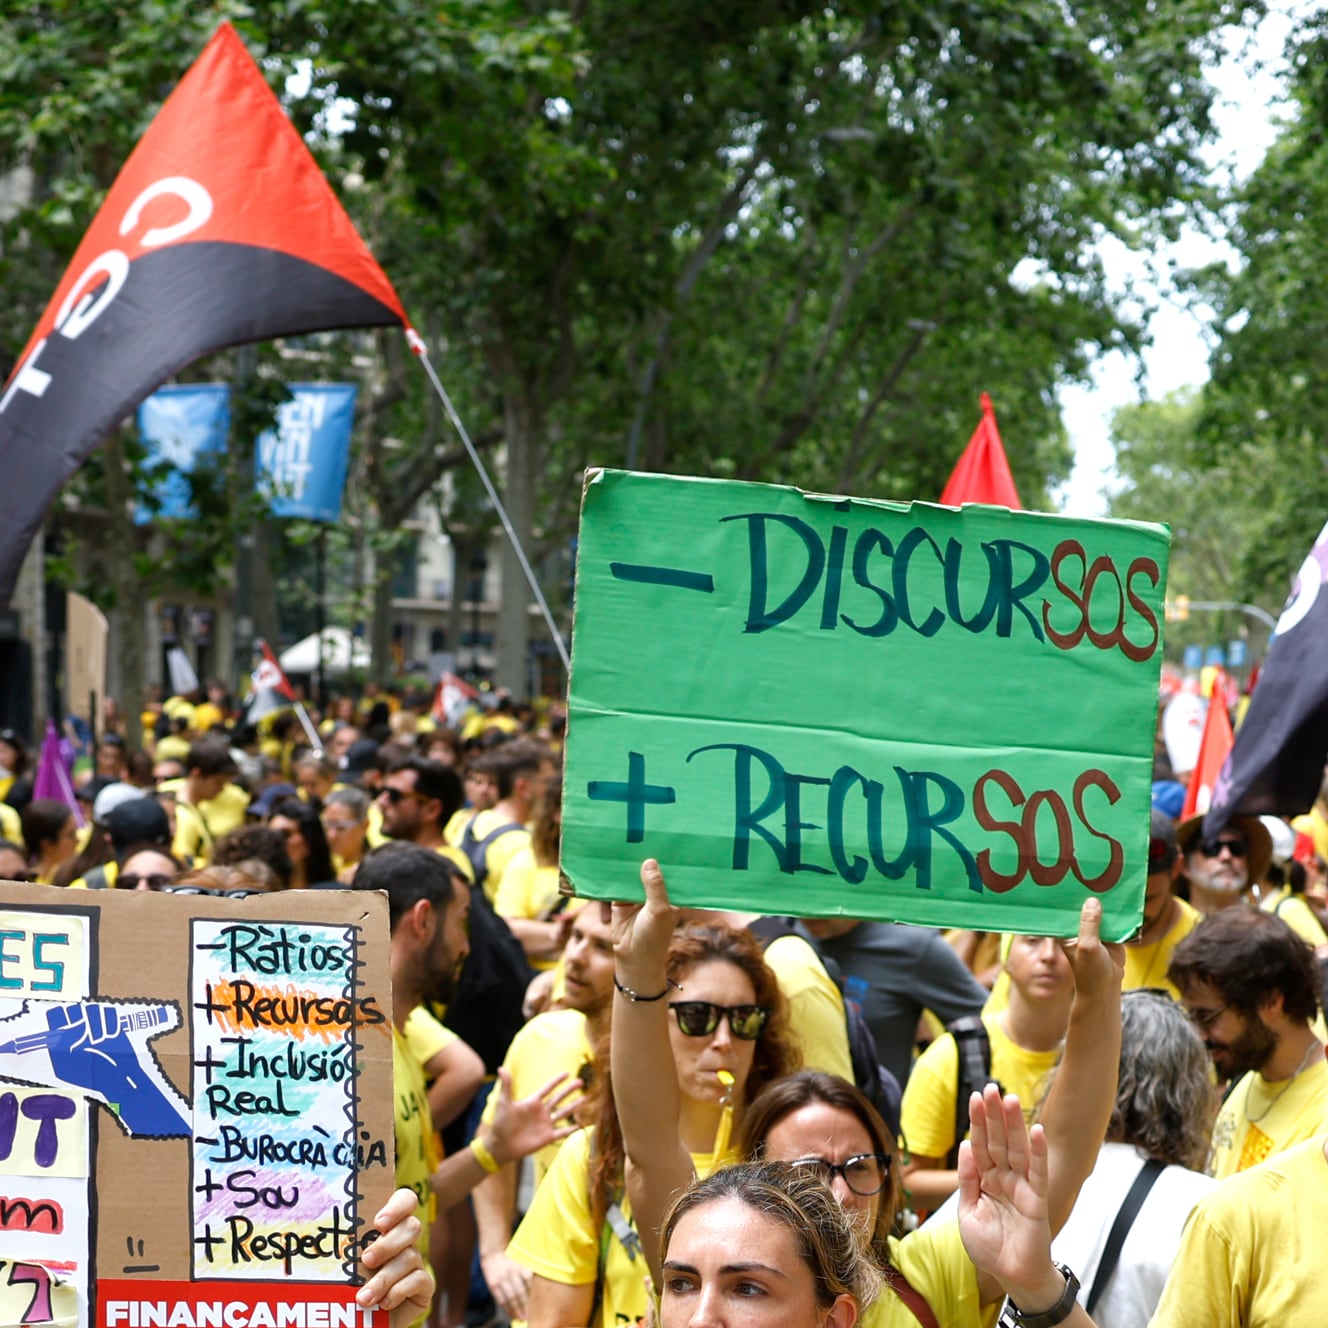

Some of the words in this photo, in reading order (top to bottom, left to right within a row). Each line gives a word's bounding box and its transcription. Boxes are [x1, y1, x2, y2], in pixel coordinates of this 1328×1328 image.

[719, 505, 1160, 663] DISCURSOS
[685, 743, 1124, 894] RECURSOS
[206, 1079, 300, 1121] Real
